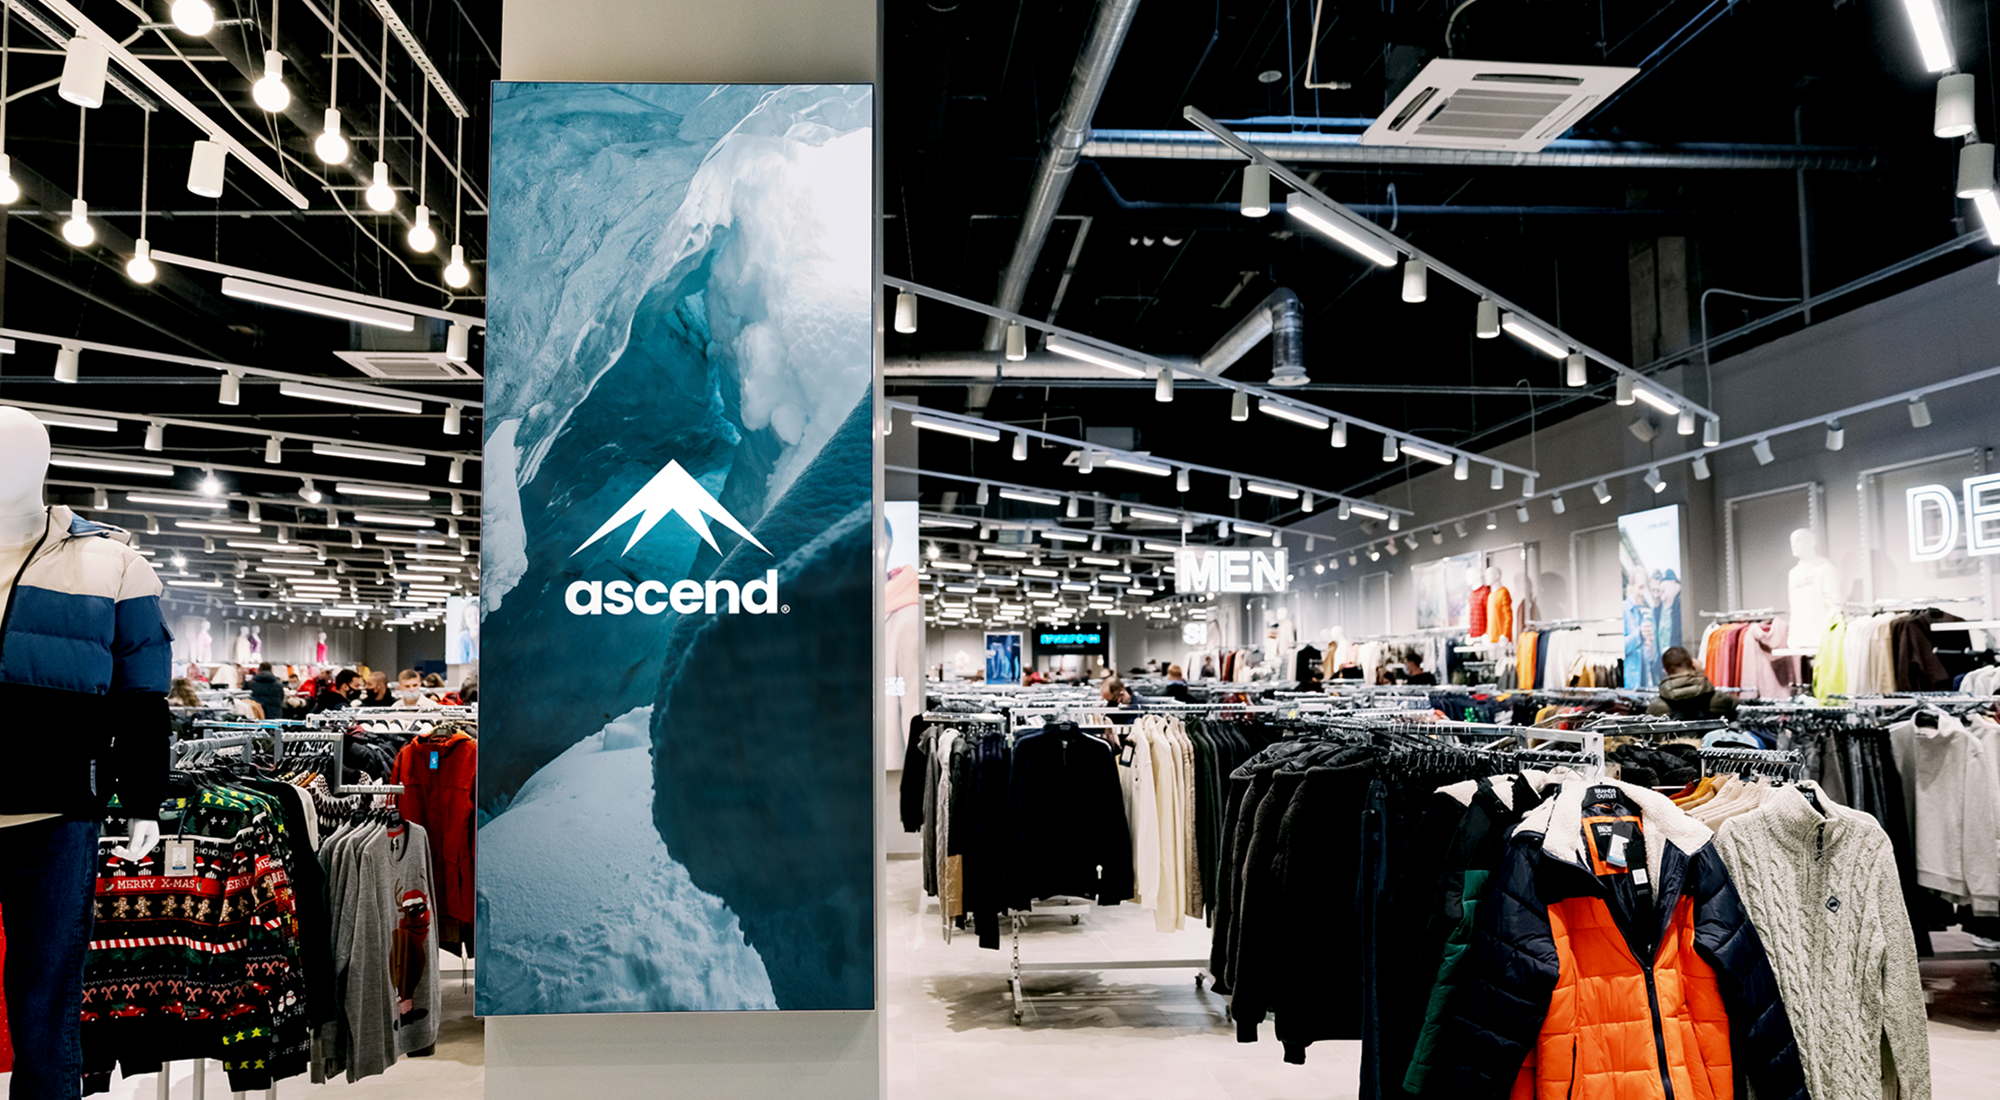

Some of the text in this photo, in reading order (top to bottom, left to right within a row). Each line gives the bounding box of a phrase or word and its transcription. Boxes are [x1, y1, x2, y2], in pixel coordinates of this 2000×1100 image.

[1180, 550, 1285, 592] MEN
[117, 878, 196, 890] MERRY X-MAS
